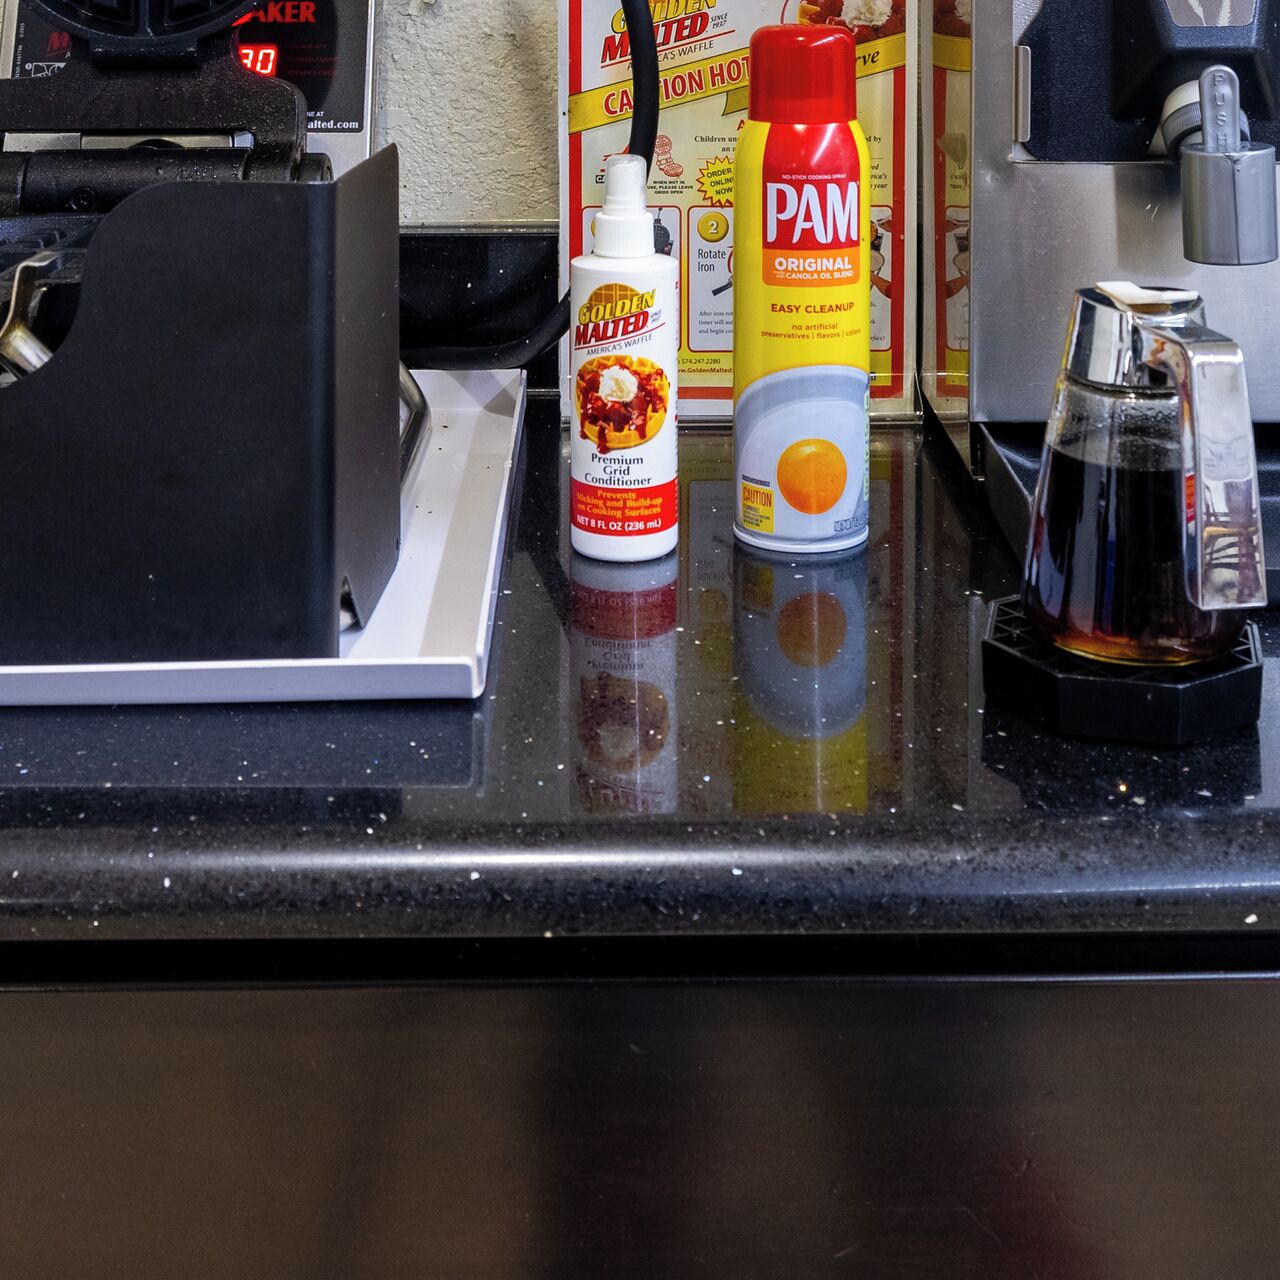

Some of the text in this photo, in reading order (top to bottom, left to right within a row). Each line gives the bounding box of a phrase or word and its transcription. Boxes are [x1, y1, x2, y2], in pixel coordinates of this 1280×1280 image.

[711, 12, 728, 24] SINCE
[600, 11, 710, 64] MLTED
[677, 40, 715, 58] WAFFLE
[604, 69, 705, 117] CAION
[307, 120, 359, 130] alted.com
[694, 135, 726, 143] Children
[706, 167, 732, 179] ORDER
[709, 176, 734, 188] ONLIN
[715, 186, 733, 196] NOW
[766, 181, 858, 244] PAM
[708, 221, 718, 234] 2
[697, 248, 727, 260] Rotate
[697, 261, 715, 272] Iron
[774, 255, 852, 271] ORIGINAL
[785, 272, 818, 280] CANOLA
[819, 271, 832, 279] OIL
[833, 270, 854, 279] BLEND
[578, 288, 656, 325] GOLDEN
[771, 303, 801, 314] EASY
[805, 301, 855, 314] CLEANUP
[574, 310, 649, 347] MALTED
[805, 322, 838, 331] artificial
[761, 330, 810, 339] preservatives
[586, 333, 653, 356] AMERICA'S WAFFLE
[591, 452, 644, 465] Premium
[603, 465, 630, 476] Grid
[584, 472, 652, 486] Conditioner
[576, 491, 604, 507] Sticking
[626, 497, 663, 508] Build-up
[597, 489, 637, 500] Prevents
[743, 486, 772, 508] CAUTION
[586, 505, 622, 519] Cooking
[624, 506, 661, 518] Surfaces
[576, 514, 662, 532] NET 8 FL OZ (236 mL)
